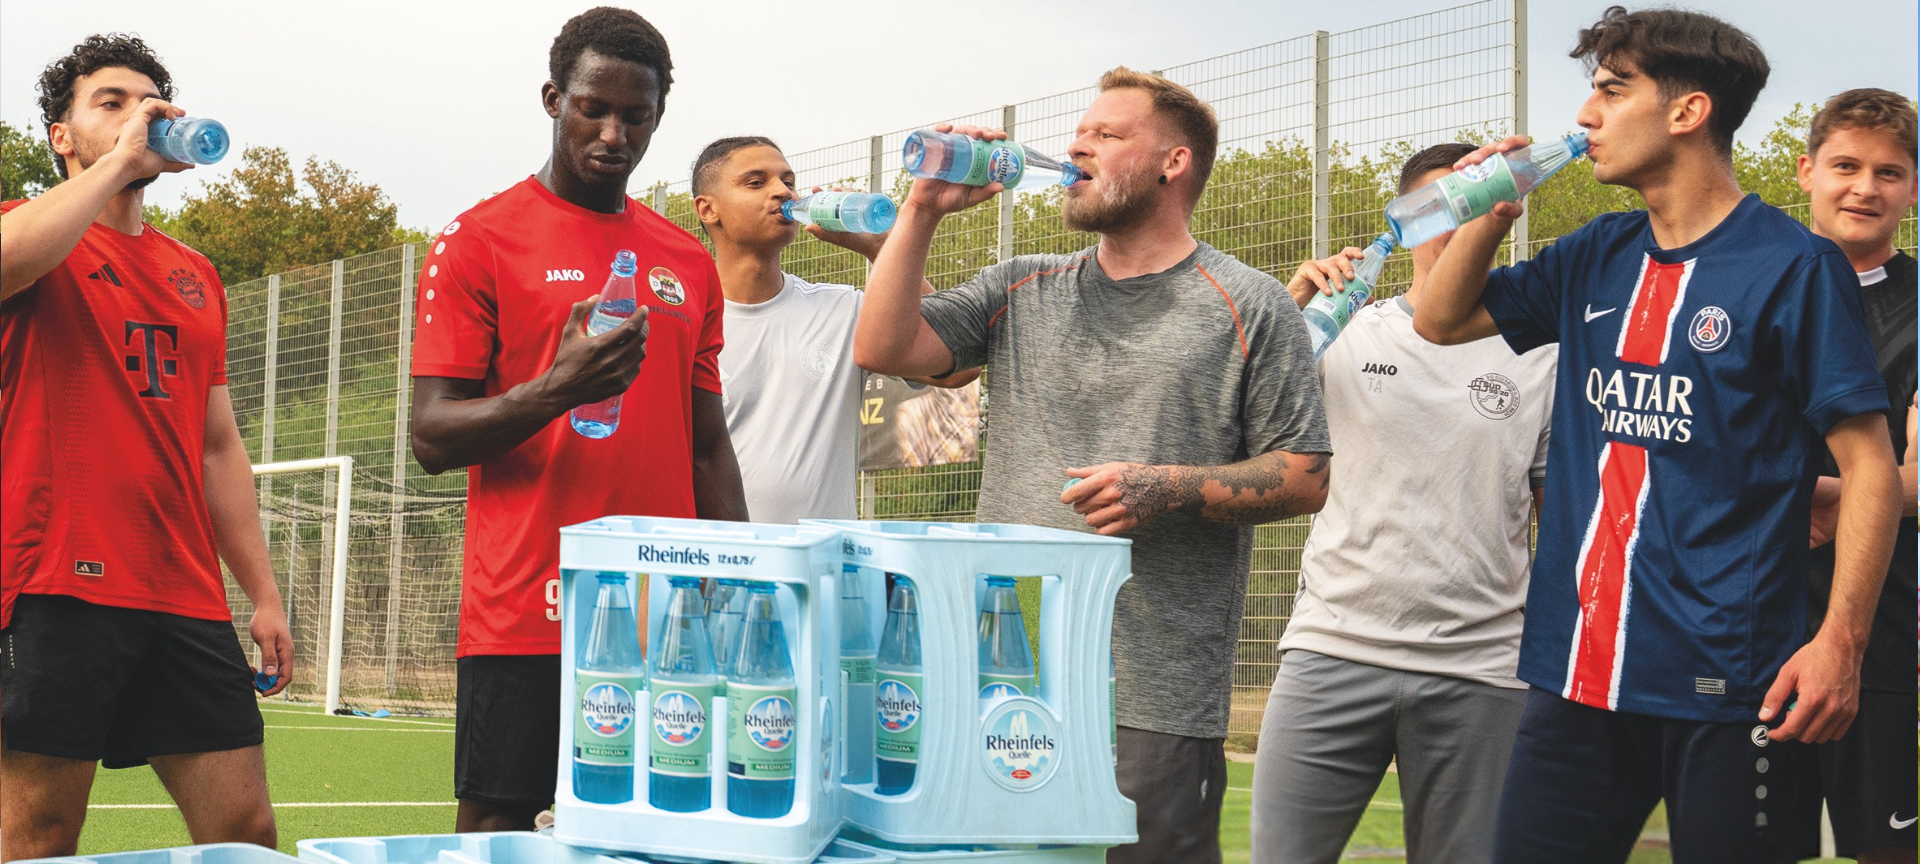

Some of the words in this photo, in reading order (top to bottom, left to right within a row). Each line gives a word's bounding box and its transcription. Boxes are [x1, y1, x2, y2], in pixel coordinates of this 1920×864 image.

[995, 147, 1010, 183] Rheinfel
[545, 269, 585, 282] JAKO
[1700, 308, 1726, 321] PARIS
[1361, 362, 1398, 376] JAKO
[1368, 377, 1382, 393] TA
[1586, 367, 1693, 416] QATAR
[1601, 409, 1693, 443] AIRWAYS
[638, 544, 710, 566] Rheinfels
[545, 578, 561, 622] 9
[582, 699, 635, 715] Rheinfels
[653, 707, 707, 724] Rheinfels
[986, 734, 1055, 751] Rheinfels
[588, 747, 626, 757] MEDIUM
[1008, 750, 1032, 760] Quelle
[658, 756, 696, 766] MEDIUM
[755, 762, 791, 771] MEDIUM
